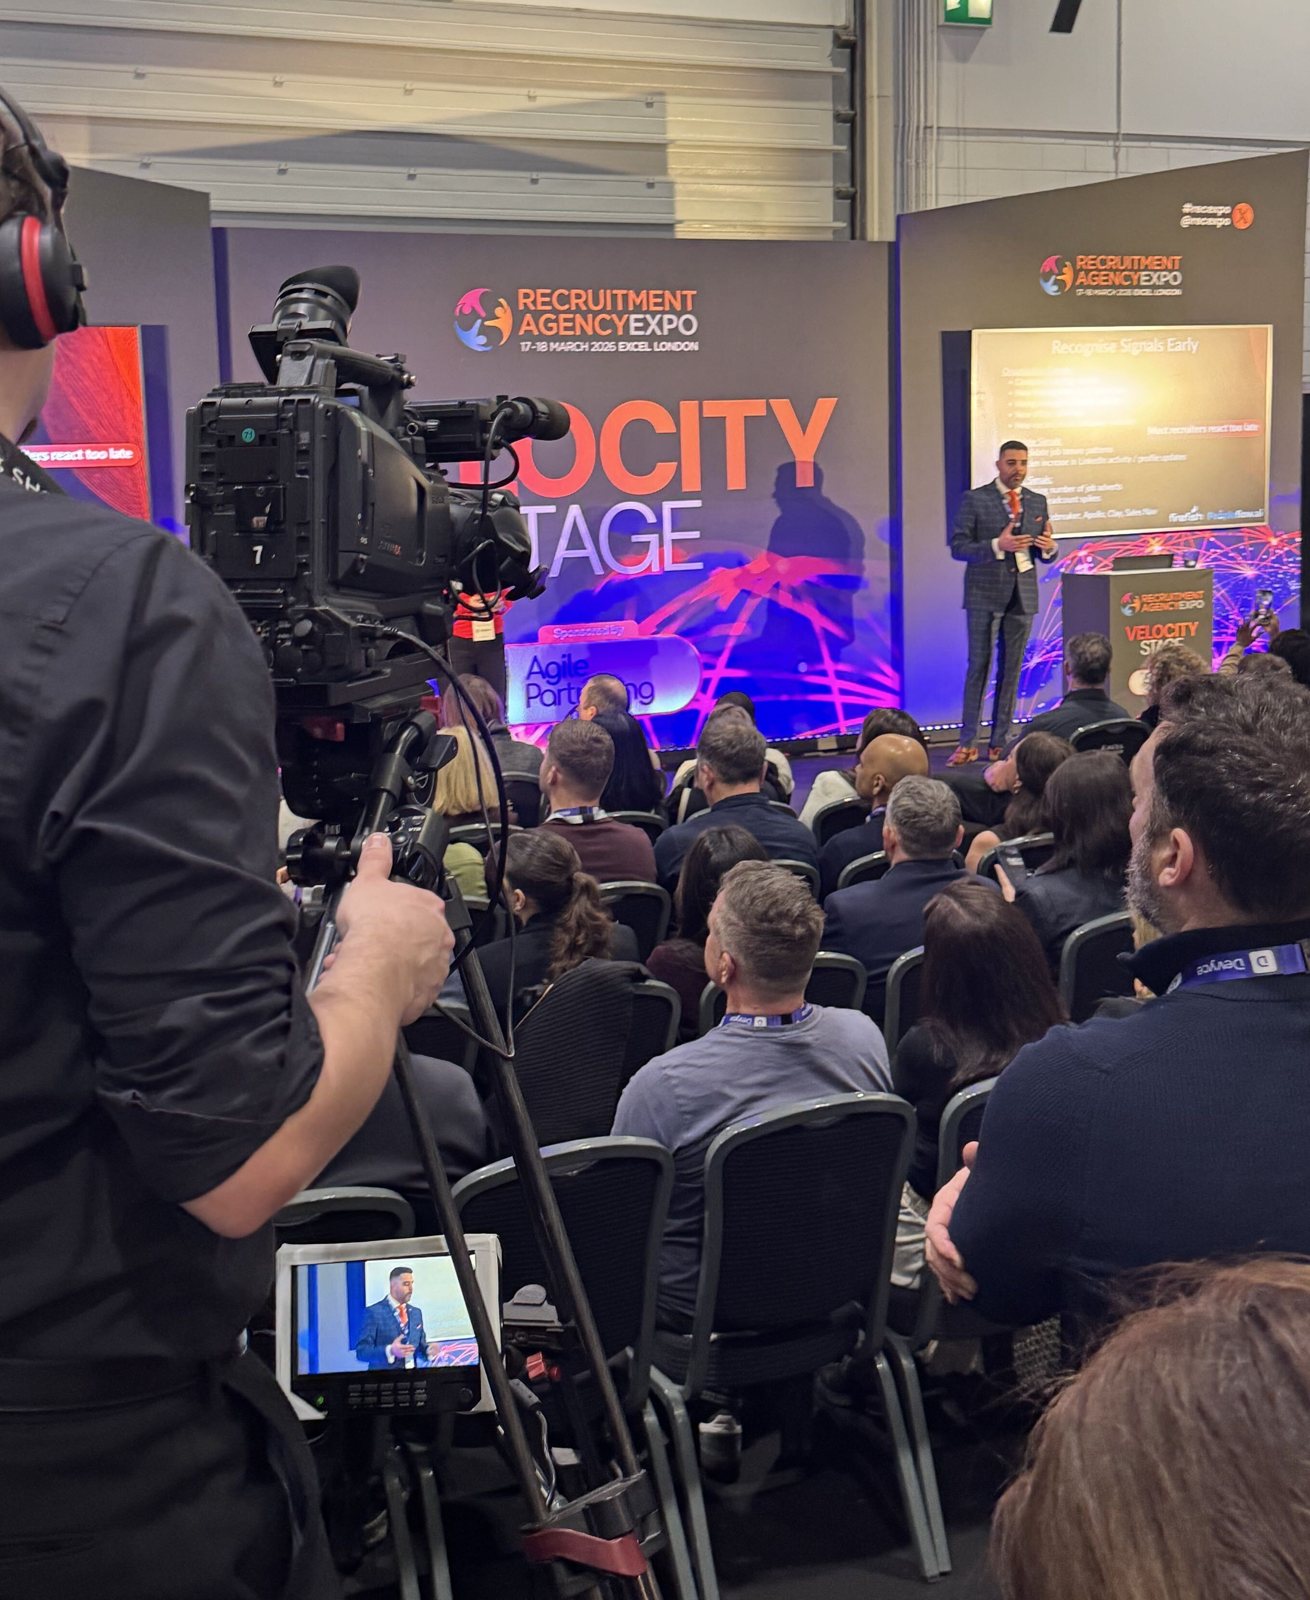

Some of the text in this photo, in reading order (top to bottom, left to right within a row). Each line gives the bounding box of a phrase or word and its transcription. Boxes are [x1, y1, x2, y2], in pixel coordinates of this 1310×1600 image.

[1075, 255, 1183, 270] RECRUITMENT
[1075, 271, 1183, 286] AGENCYEXPO
[517, 288, 697, 312] RECRUITMENT
[518, 313, 699, 336] AGENCYEXPO
[520, 341, 549, 352] 17-18
[550, 341, 589, 352] MARCH
[618, 341, 652, 352] EXCEL
[653, 341, 699, 353] LONDON
[1051, 336, 1200, 357] Recognise Signals Early
[51, 448, 84, 461] react
[85, 448, 108, 460] too
[108, 447, 134, 460] late
[459, 397, 838, 498] OCITY
[520, 499, 704, 578] TAGE
[252, 545, 264, 565] 7
[1140, 590, 1205, 603] RECRUITMENT
[1140, 601, 1205, 613] AGENCYEXPO
[1124, 621, 1199, 641] VELOCITY
[525, 653, 590, 685] Agile
[525, 681, 655, 709] Partng
[1196, 957, 1246, 976] Devyce
